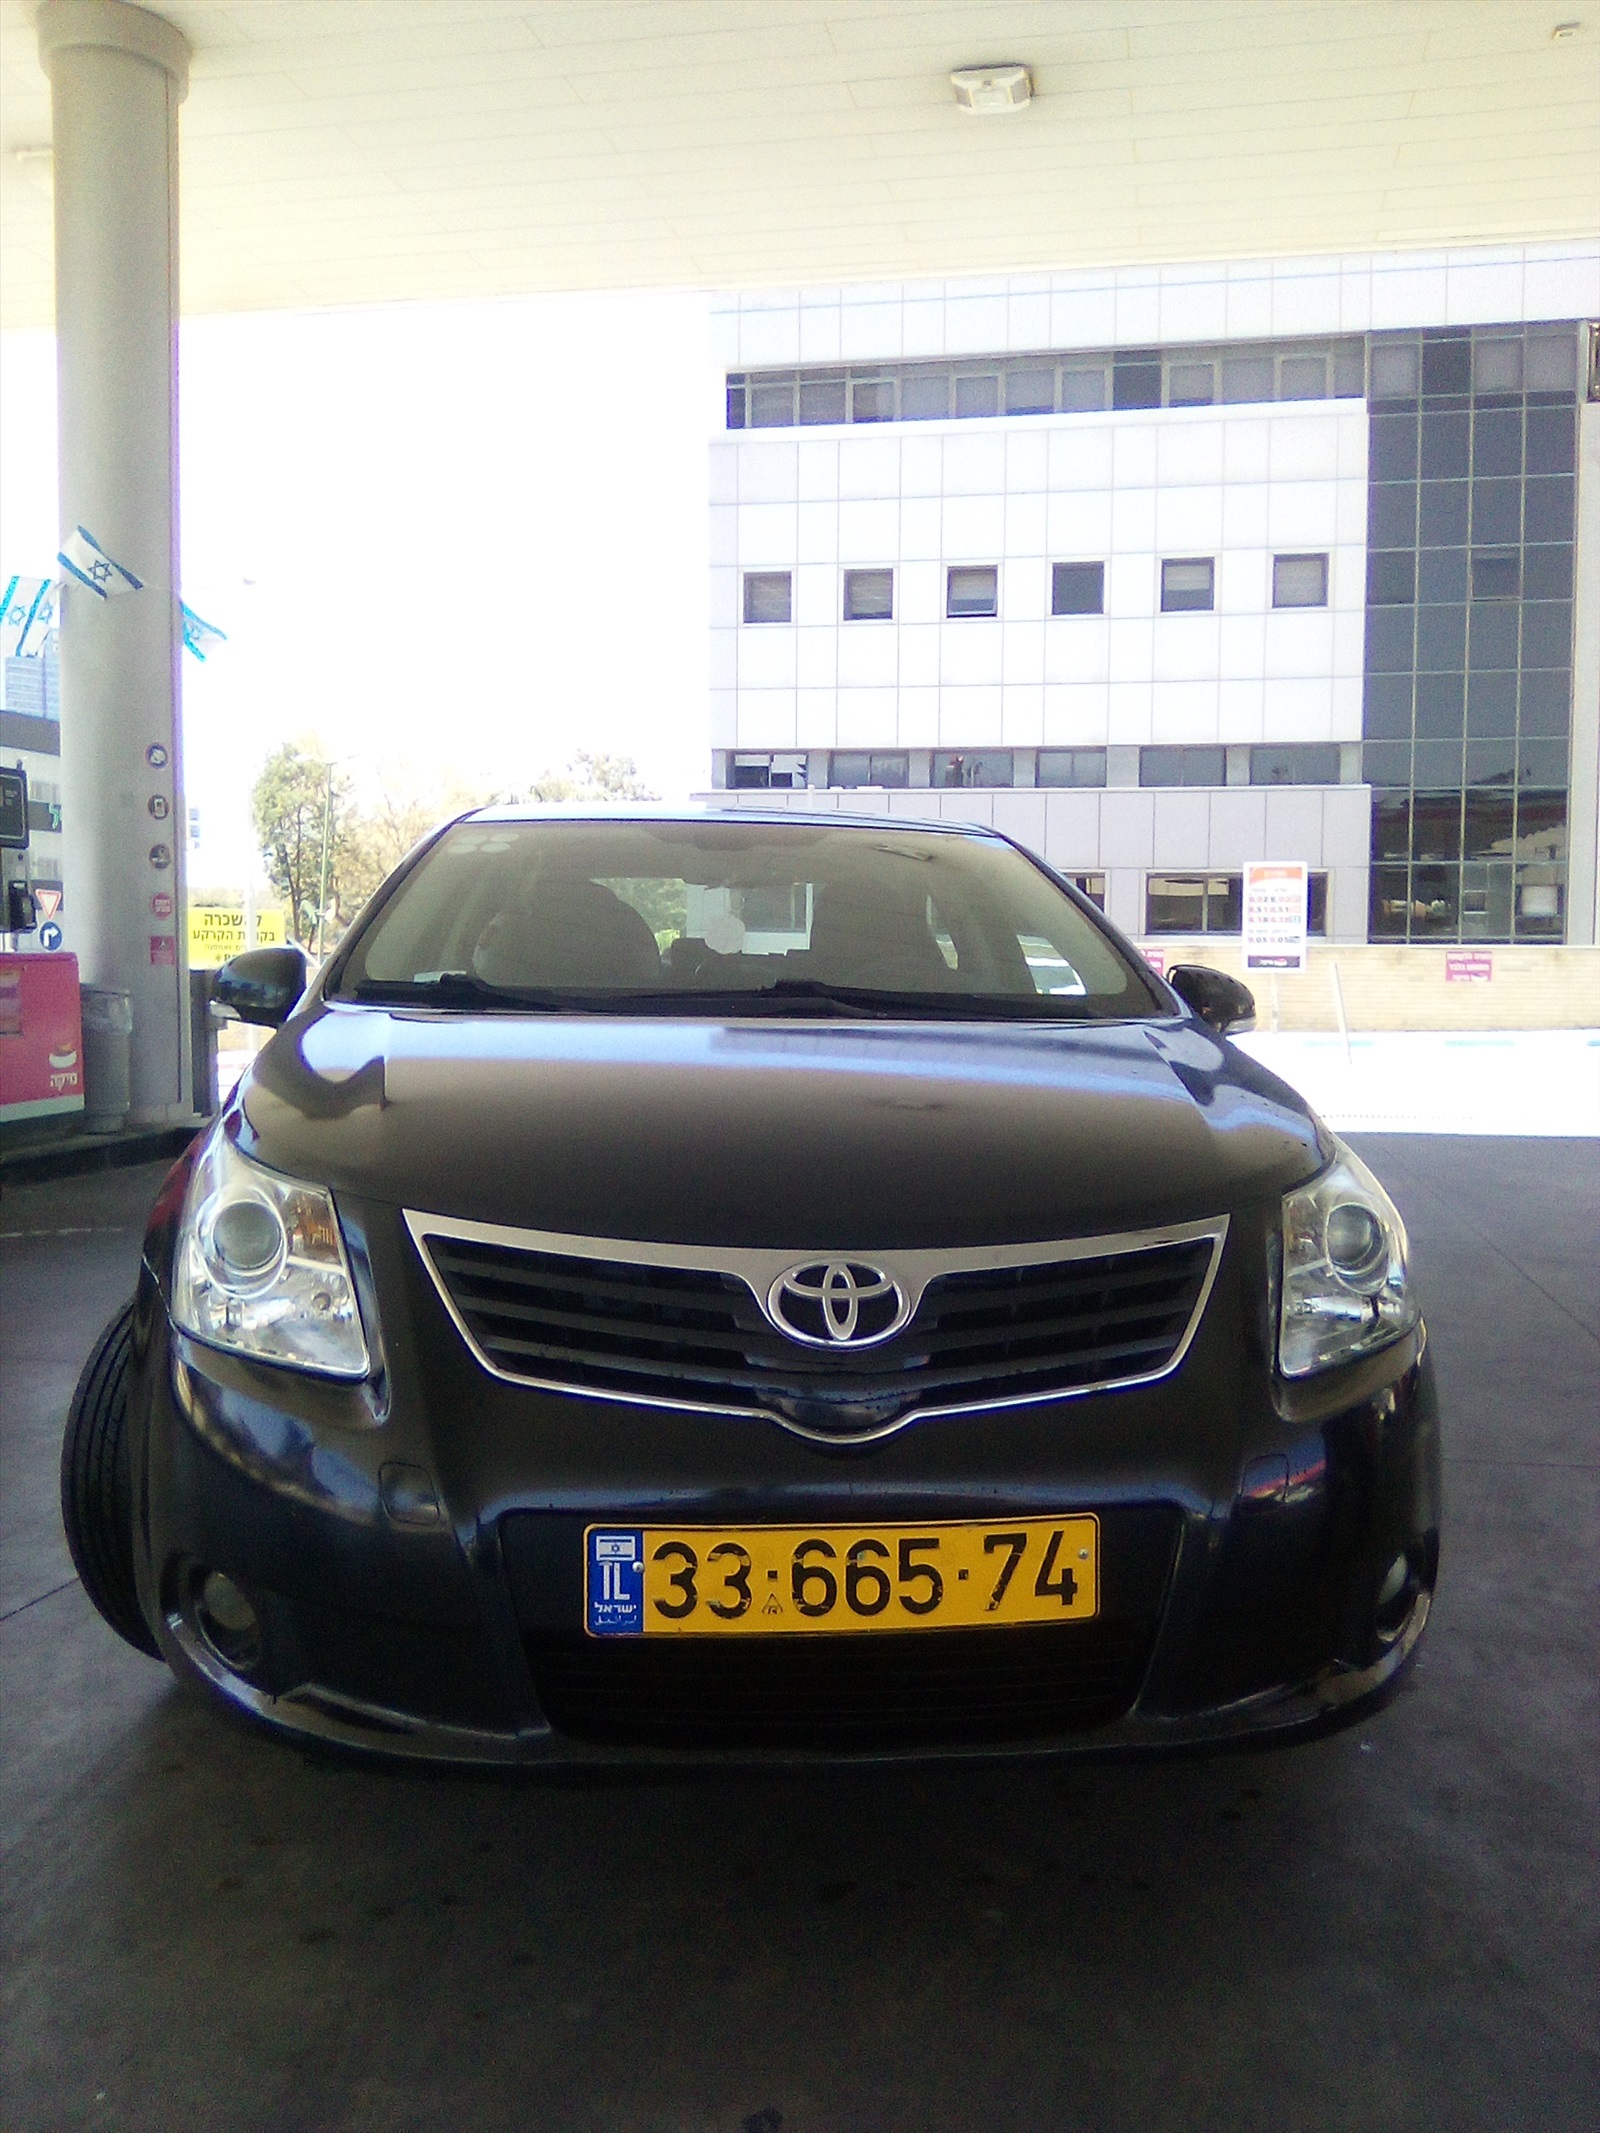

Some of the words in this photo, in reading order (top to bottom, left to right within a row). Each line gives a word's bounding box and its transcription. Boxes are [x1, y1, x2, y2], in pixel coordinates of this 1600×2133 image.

[204, 913, 262, 927] לשכרה
[193, 929, 233, 941] הקרקע
[599, 1561, 630, 1601] IL
[594, 1601, 637, 1614] ישראל
